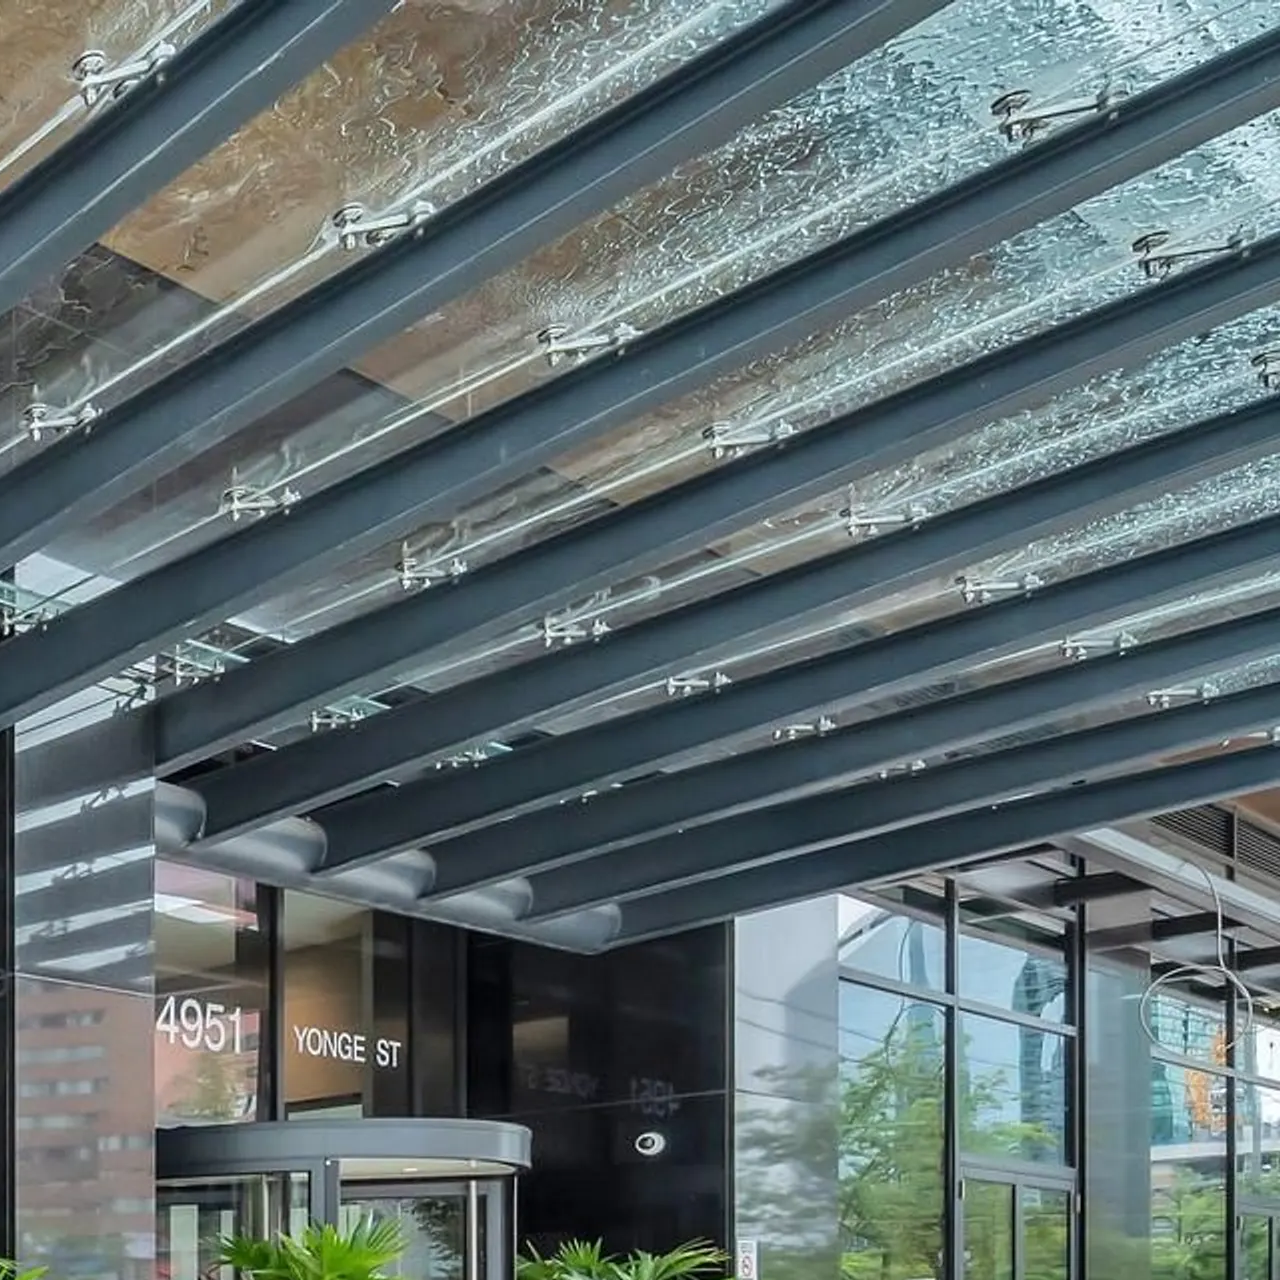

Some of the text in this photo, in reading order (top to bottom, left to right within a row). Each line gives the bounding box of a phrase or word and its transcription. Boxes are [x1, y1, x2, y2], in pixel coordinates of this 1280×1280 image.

[156, 995, 242, 1054] 4951
[293, 1025, 401, 1067] YONGE ST
